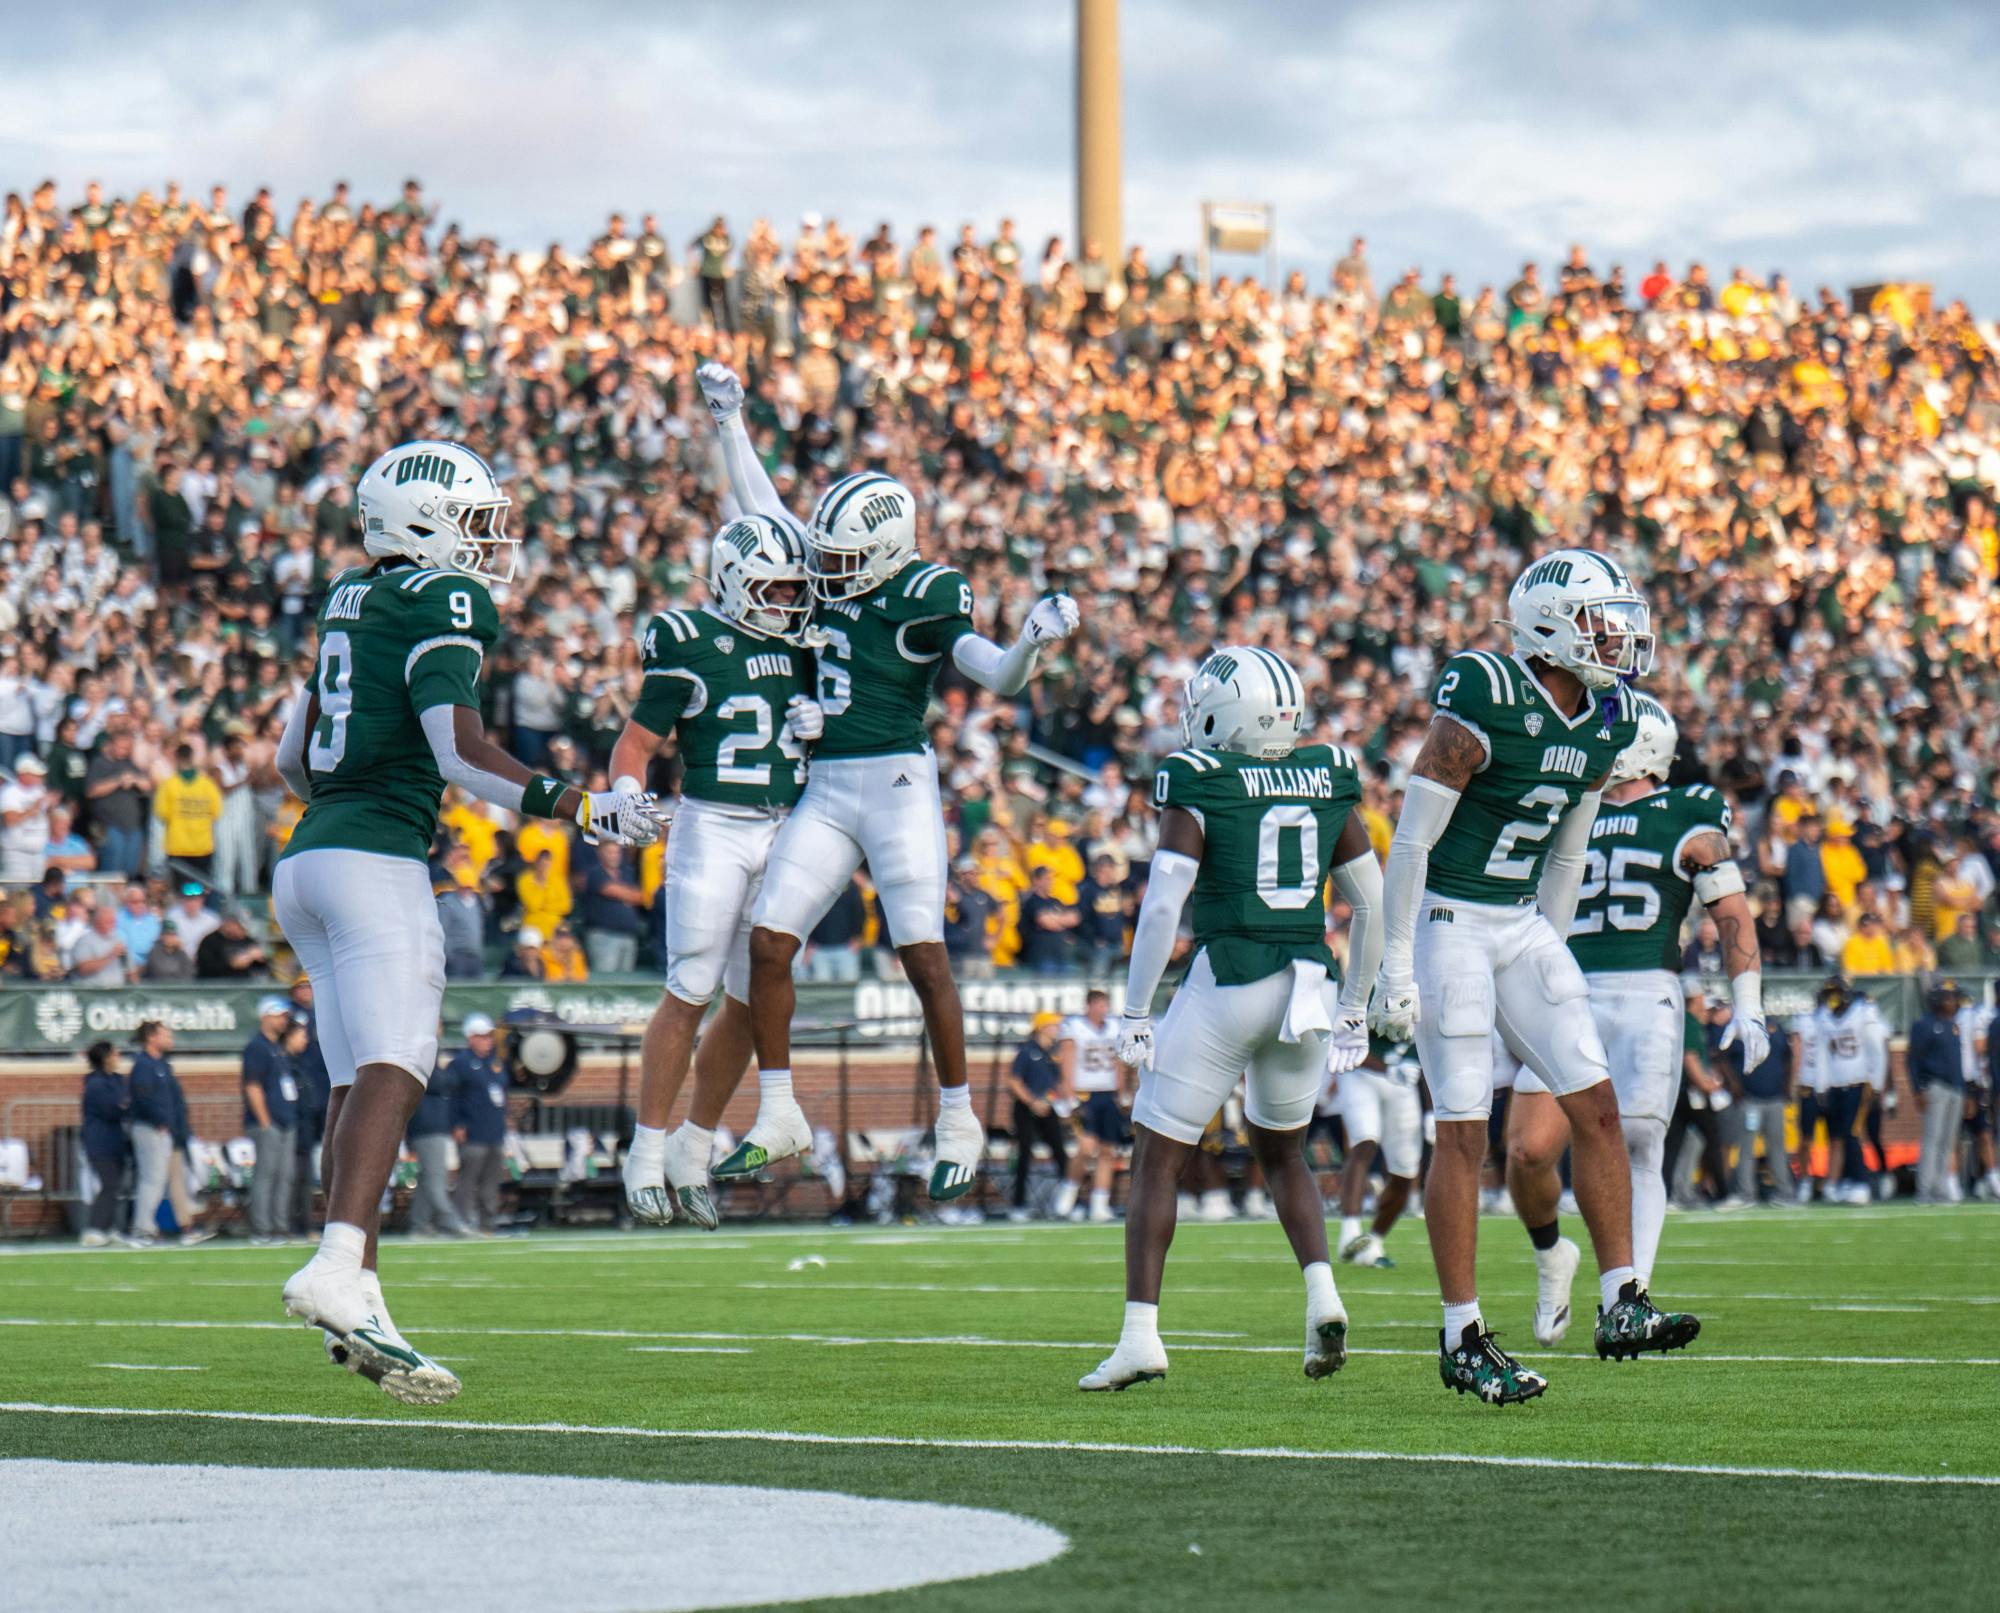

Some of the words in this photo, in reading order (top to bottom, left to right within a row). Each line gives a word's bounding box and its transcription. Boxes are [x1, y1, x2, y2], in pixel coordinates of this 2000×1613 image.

[396, 455, 456, 491] OHIO
[860, 494, 903, 533] OHIO
[1524, 560, 1574, 594] OHIO
[449, 591, 472, 629] 9
[958, 584, 973, 614] 6
[746, 654, 792, 680] OHIO
[308, 631, 352, 772] 9
[1437, 671, 1460, 706] 2
[1520, 680, 1535, 705] C
[1540, 745, 1587, 778] OHIO
[1156, 771, 1169, 802] 0
[1238, 767, 1332, 798] WILLIAMS
[1484, 785, 1569, 879] 2
[1592, 815, 1638, 839] OHIO
[1256, 805, 1319, 909] 0
[1568, 848, 1663, 935] 25
[1429, 906, 1454, 923] OHIO
[1618, 1314, 1630, 1334] 2
